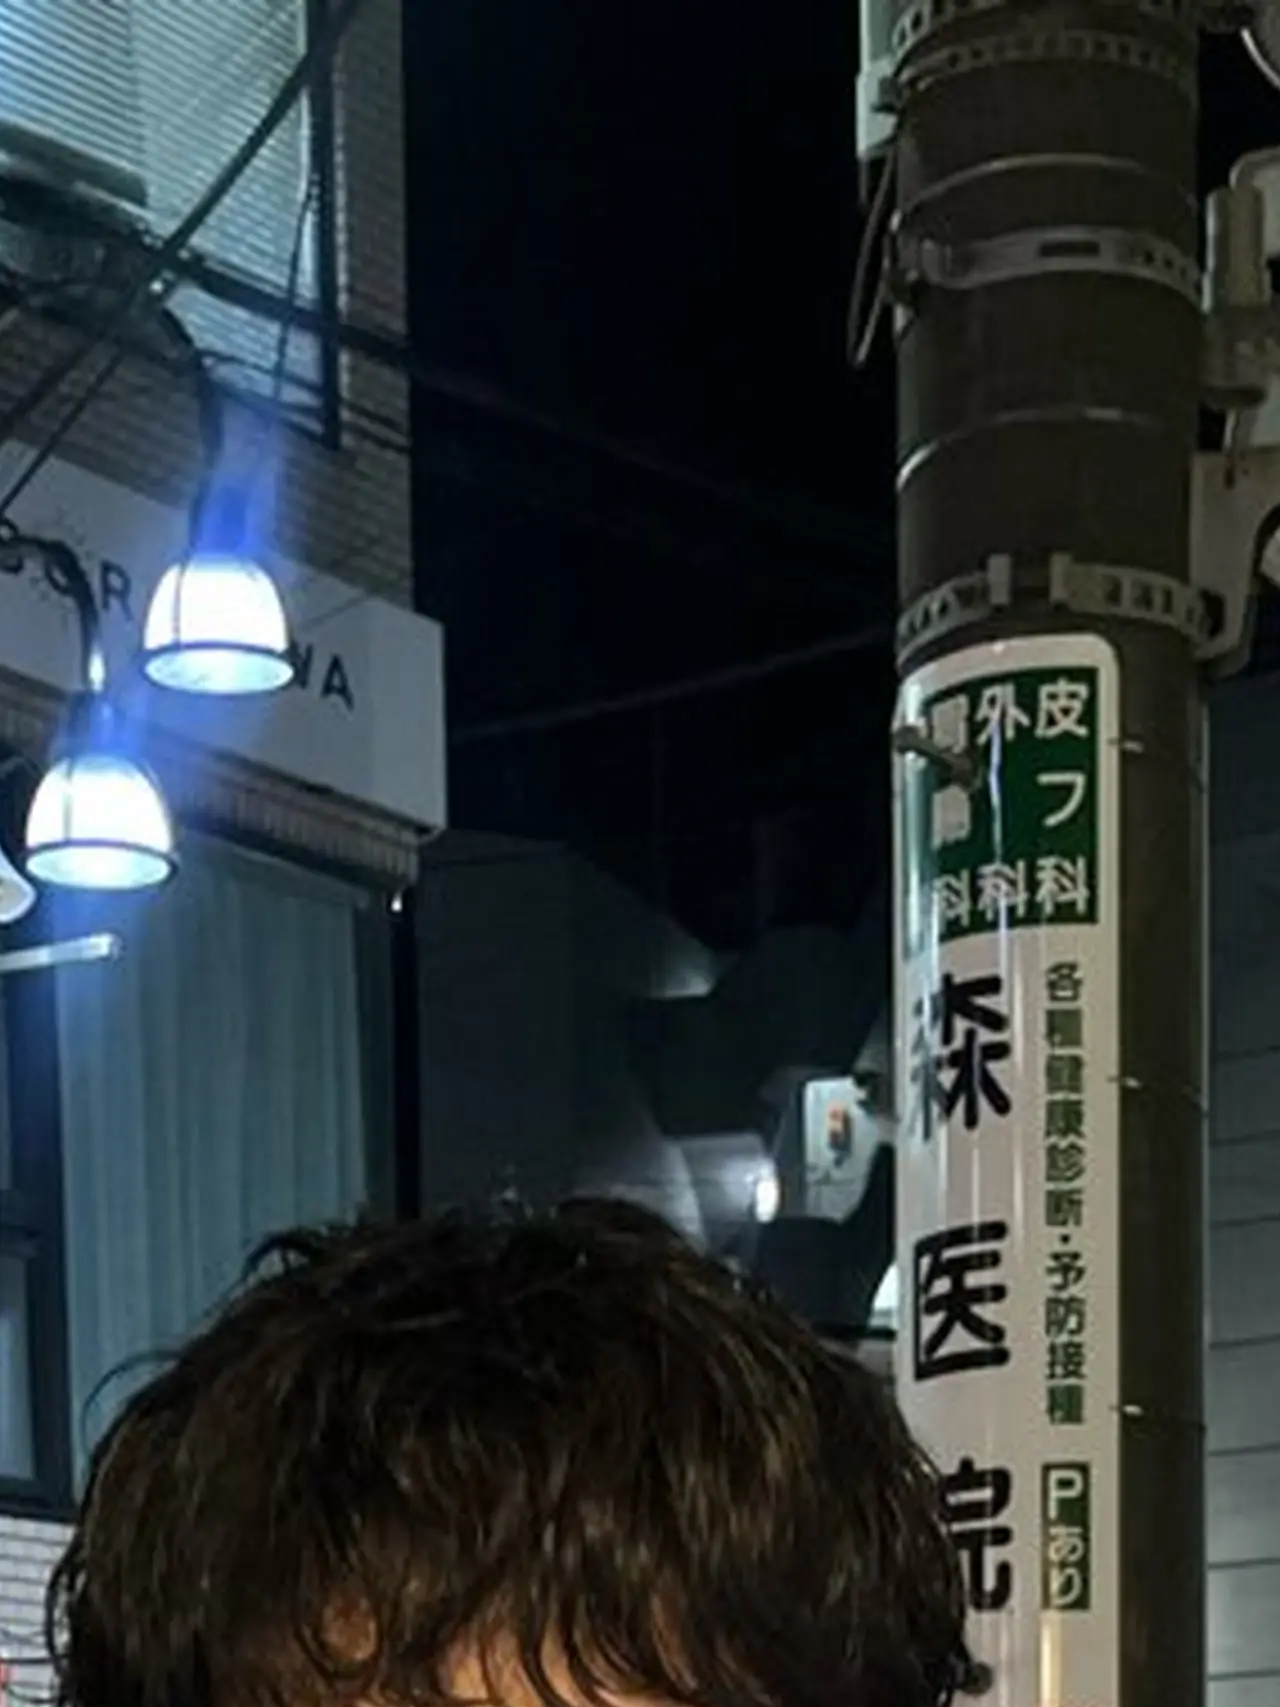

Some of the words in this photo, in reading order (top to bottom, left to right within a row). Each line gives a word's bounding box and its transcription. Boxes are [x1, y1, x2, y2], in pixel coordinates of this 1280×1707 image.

[975, 682, 1029, 922] 外科
[1034, 676, 1089, 915] 皮フ科
[1047, 1468, 1085, 1606] Pあり
